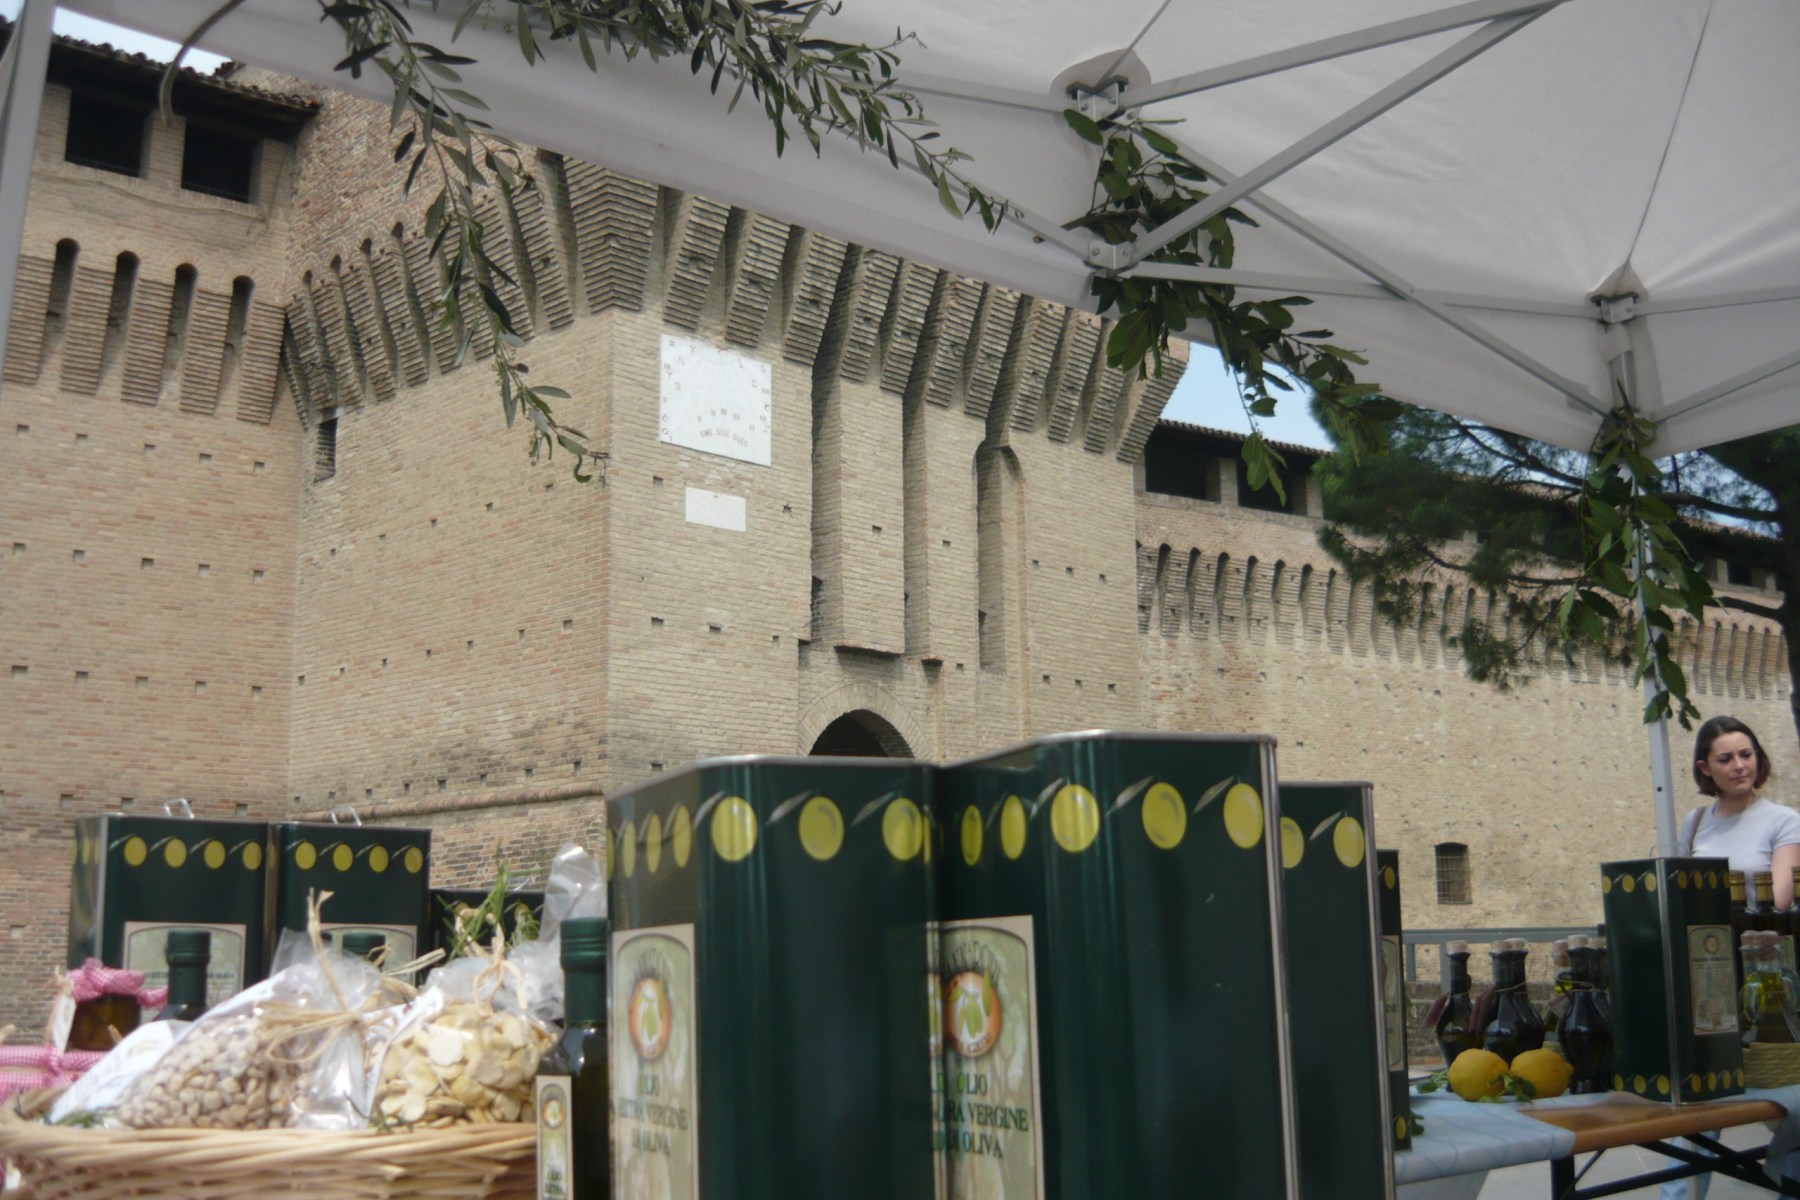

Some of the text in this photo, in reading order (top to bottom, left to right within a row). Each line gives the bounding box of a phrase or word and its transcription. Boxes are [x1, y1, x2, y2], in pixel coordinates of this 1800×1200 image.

[716, 428, 730, 438] SOLE
[956, 1072, 988, 1096] OLIO
[967, 1102, 1029, 1132] VERGINE
[963, 1130, 1004, 1158] OLIVA
